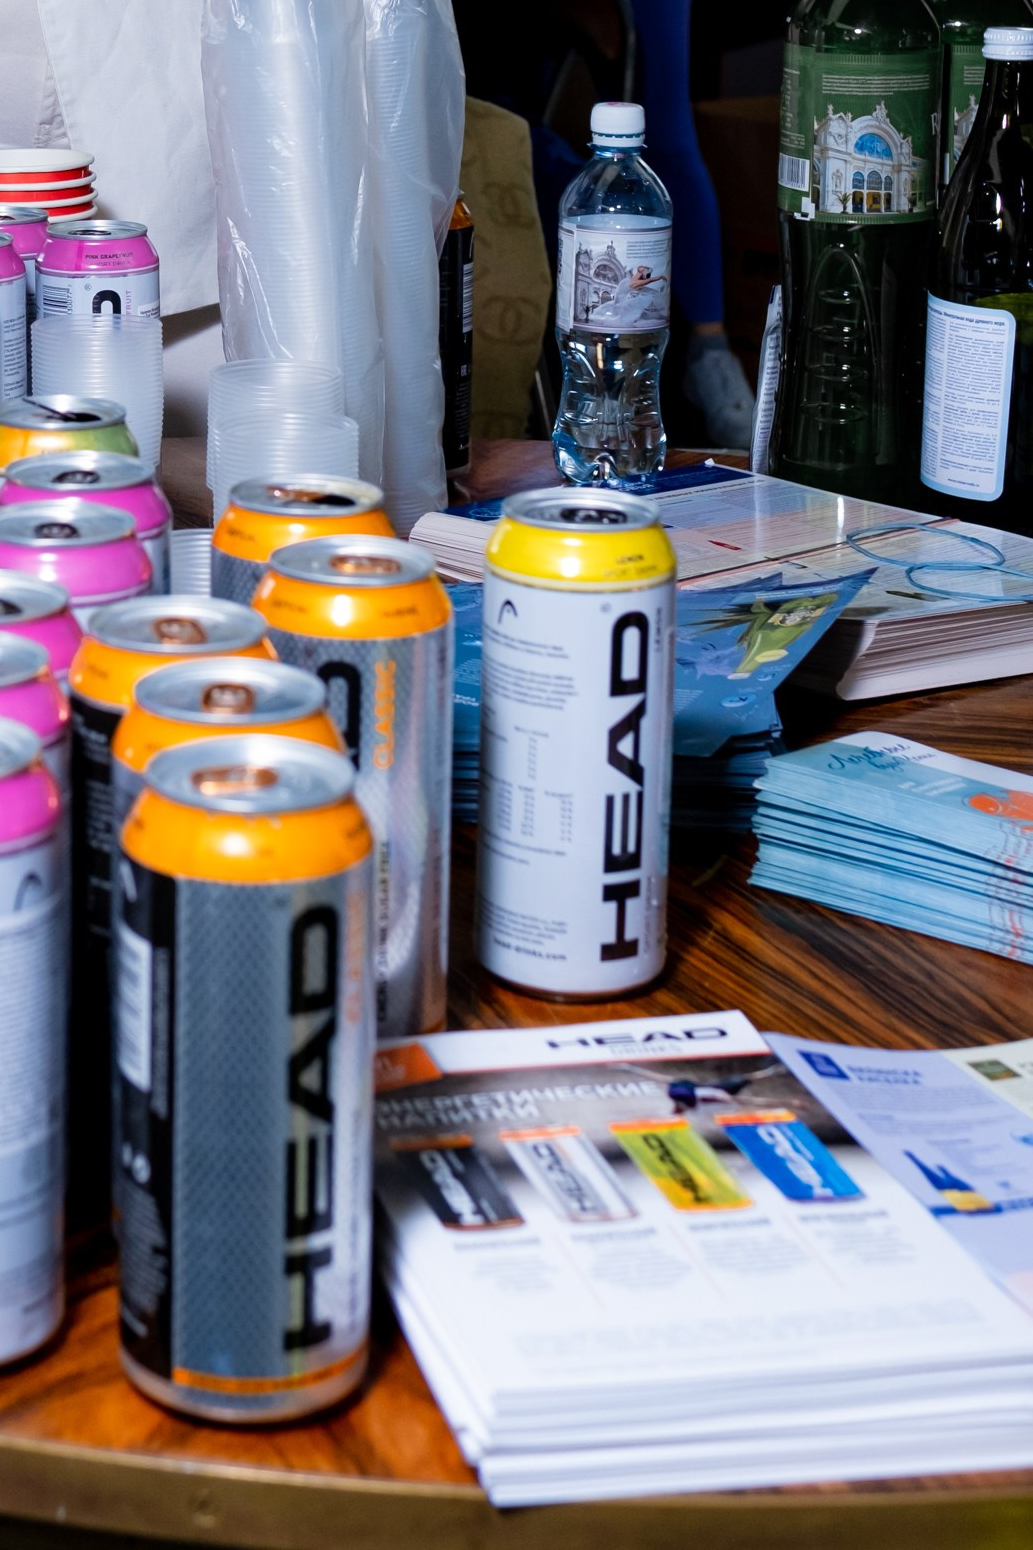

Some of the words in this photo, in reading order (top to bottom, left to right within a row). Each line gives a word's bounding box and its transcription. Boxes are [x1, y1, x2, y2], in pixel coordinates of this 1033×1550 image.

[100, 252, 133, 260] GRAPEFRUIT
[616, 554, 644, 564] LEMON
[373, 660, 396, 769] CLASSIC
[600, 610, 649, 962] HEAD
[546, 1027, 728, 1049] HEAD
[376, 1080, 660, 1115] ЭНЕРГЕТИЧЕСКИЕ
[283, 905, 339, 1353] HEAD
[375, 1100, 540, 1130] НАПИТКИ
